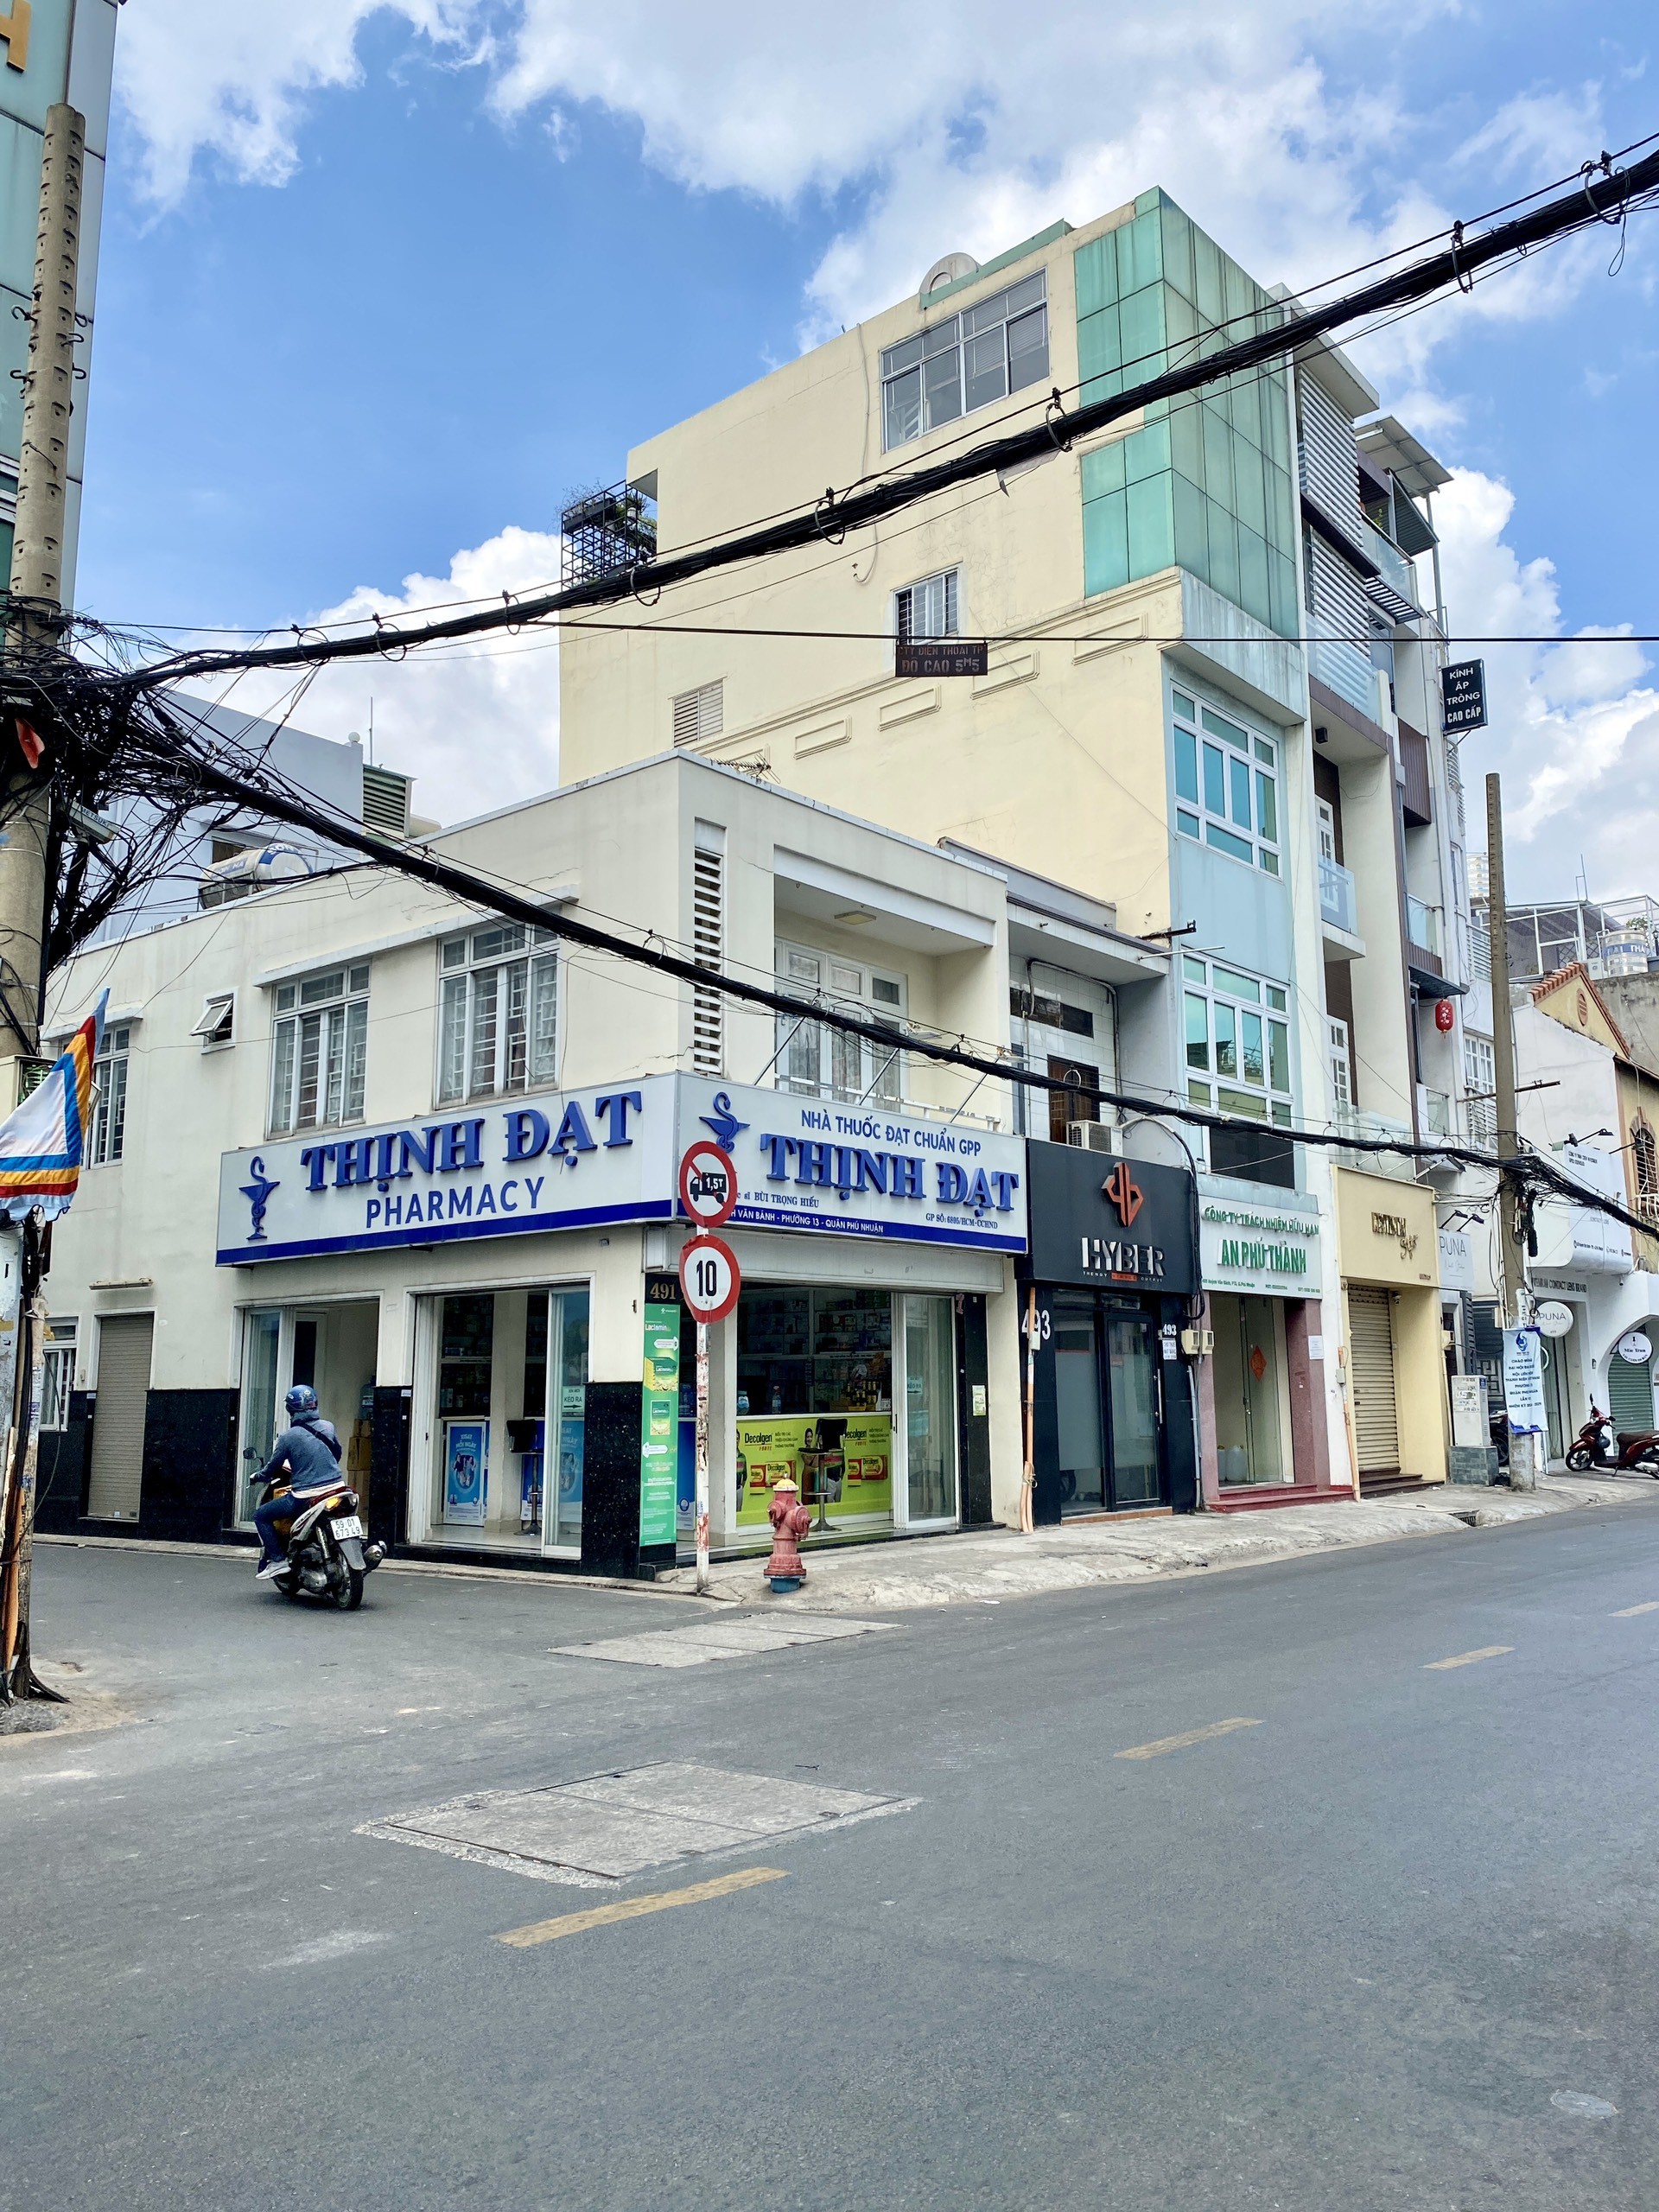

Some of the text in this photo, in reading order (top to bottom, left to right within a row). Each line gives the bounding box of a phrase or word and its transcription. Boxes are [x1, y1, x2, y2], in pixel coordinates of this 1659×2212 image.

[924, 658, 950, 673] CAO
[1449, 667, 1474, 680] KÍNH
[1455, 681, 1470, 691] ÁP
[1446, 691, 1481, 706] TRÒNG
[1447, 704, 1482, 723] CAO CẤP
[300, 1090, 642, 1192] THỊNH ĐẠT
[801, 1109, 982, 1156] NHÀ THUỐC ĐẠT CHUẨN GPP
[760, 1133, 1020, 1217] THỊNH ĐẠT
[365, 1176, 545, 1229] PHARMACY
[754, 1192, 769, 1202] BÙI
[771, 1194, 798, 1205] TRỌNG
[800, 1196, 820, 1208] HIẾU
[738, 1208, 754, 1219] VĂN
[755, 1210, 775, 1222] BÁNH
[781, 1213, 810, 1226] PHƯỜNG
[812, 1217, 820, 1226] 13
[825, 1219, 846, 1230] QUẬN
[846, 1219, 860, 1230] PHÚ
[861, 1222, 884, 1235] NHUẬN
[925, 1212, 935, 1221] GP
[1202, 1205, 1227, 1223] CÔNG
[1227, 1211, 1238, 1224] TY
[1238, 1211, 1264, 1228] TRÁCH
[1217, 1236, 1307, 1274] AN PHÚ THÀNH
[1439, 1236, 1467, 1257] PUNA
[1081, 1236, 1166, 1277] HYBER
[696, 1260, 717, 1297] 10
[650, 1282, 677, 1300] 491
[1539, 1312, 1567, 1321] PUNA
[1162, 1323, 1177, 1336] 493
[744, 1432, 772, 1445] Decolgen
[844, 1428, 868, 1440] ecolgen
[335, 1520, 344, 1529] 59
